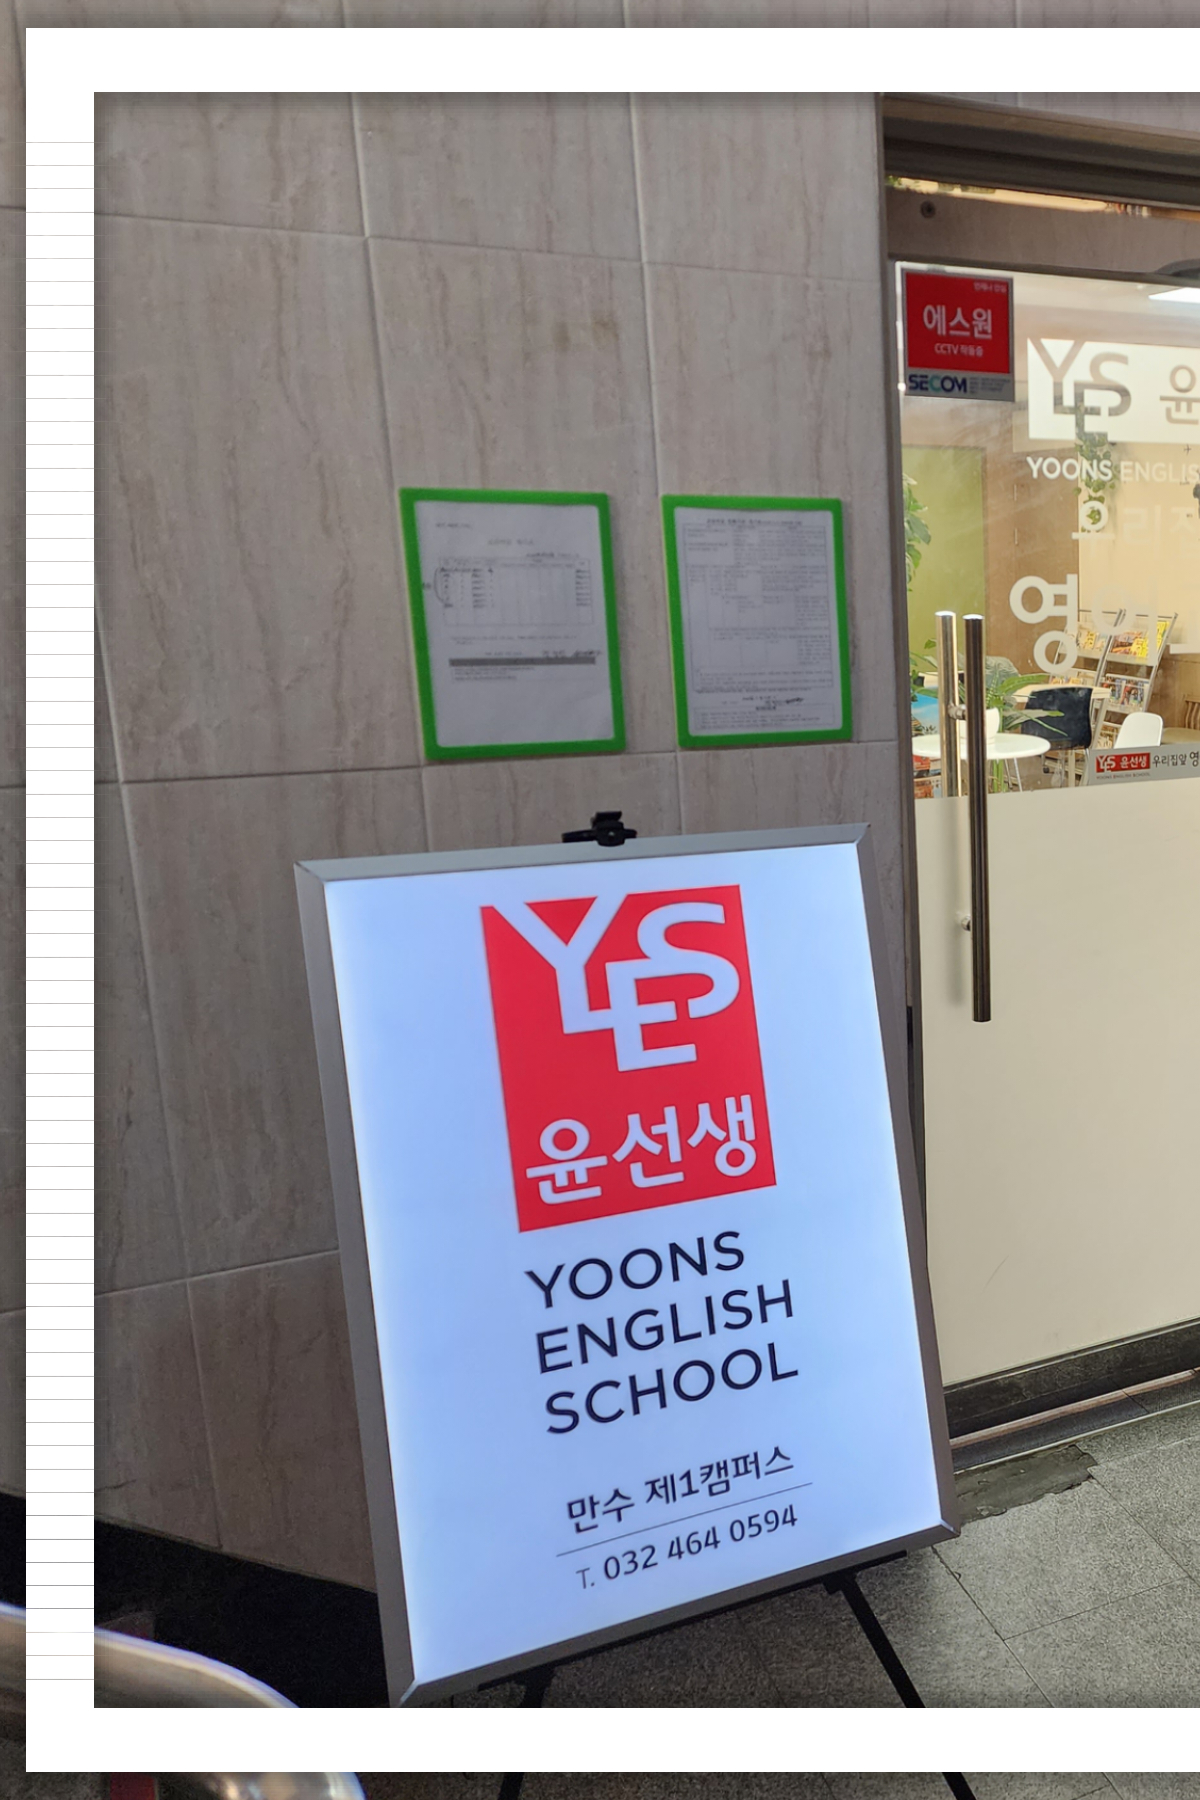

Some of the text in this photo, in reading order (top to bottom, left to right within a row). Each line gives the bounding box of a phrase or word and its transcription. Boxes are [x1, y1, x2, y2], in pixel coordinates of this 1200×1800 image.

[922, 304, 992, 339] 에스원
[934, 342, 959, 356] CCTV
[908, 373, 968, 394] SECOM
[1026, 456, 1113, 482] YOONS
[1120, 754, 1148, 769] 윤선생
[1152, 754, 1188, 769] 우리집앞
[491, 892, 740, 1072] YES
[526, 1094, 757, 1205] 윤선생
[524, 1230, 745, 1309] YOONS
[536, 1279, 794, 1374] ENGLISH
[545, 1342, 799, 1434] SCHOOL
[566, 1446, 795, 1534] 만수 제1캠퍼스
[574, 1503, 798, 1590] T. 032 464 0594
